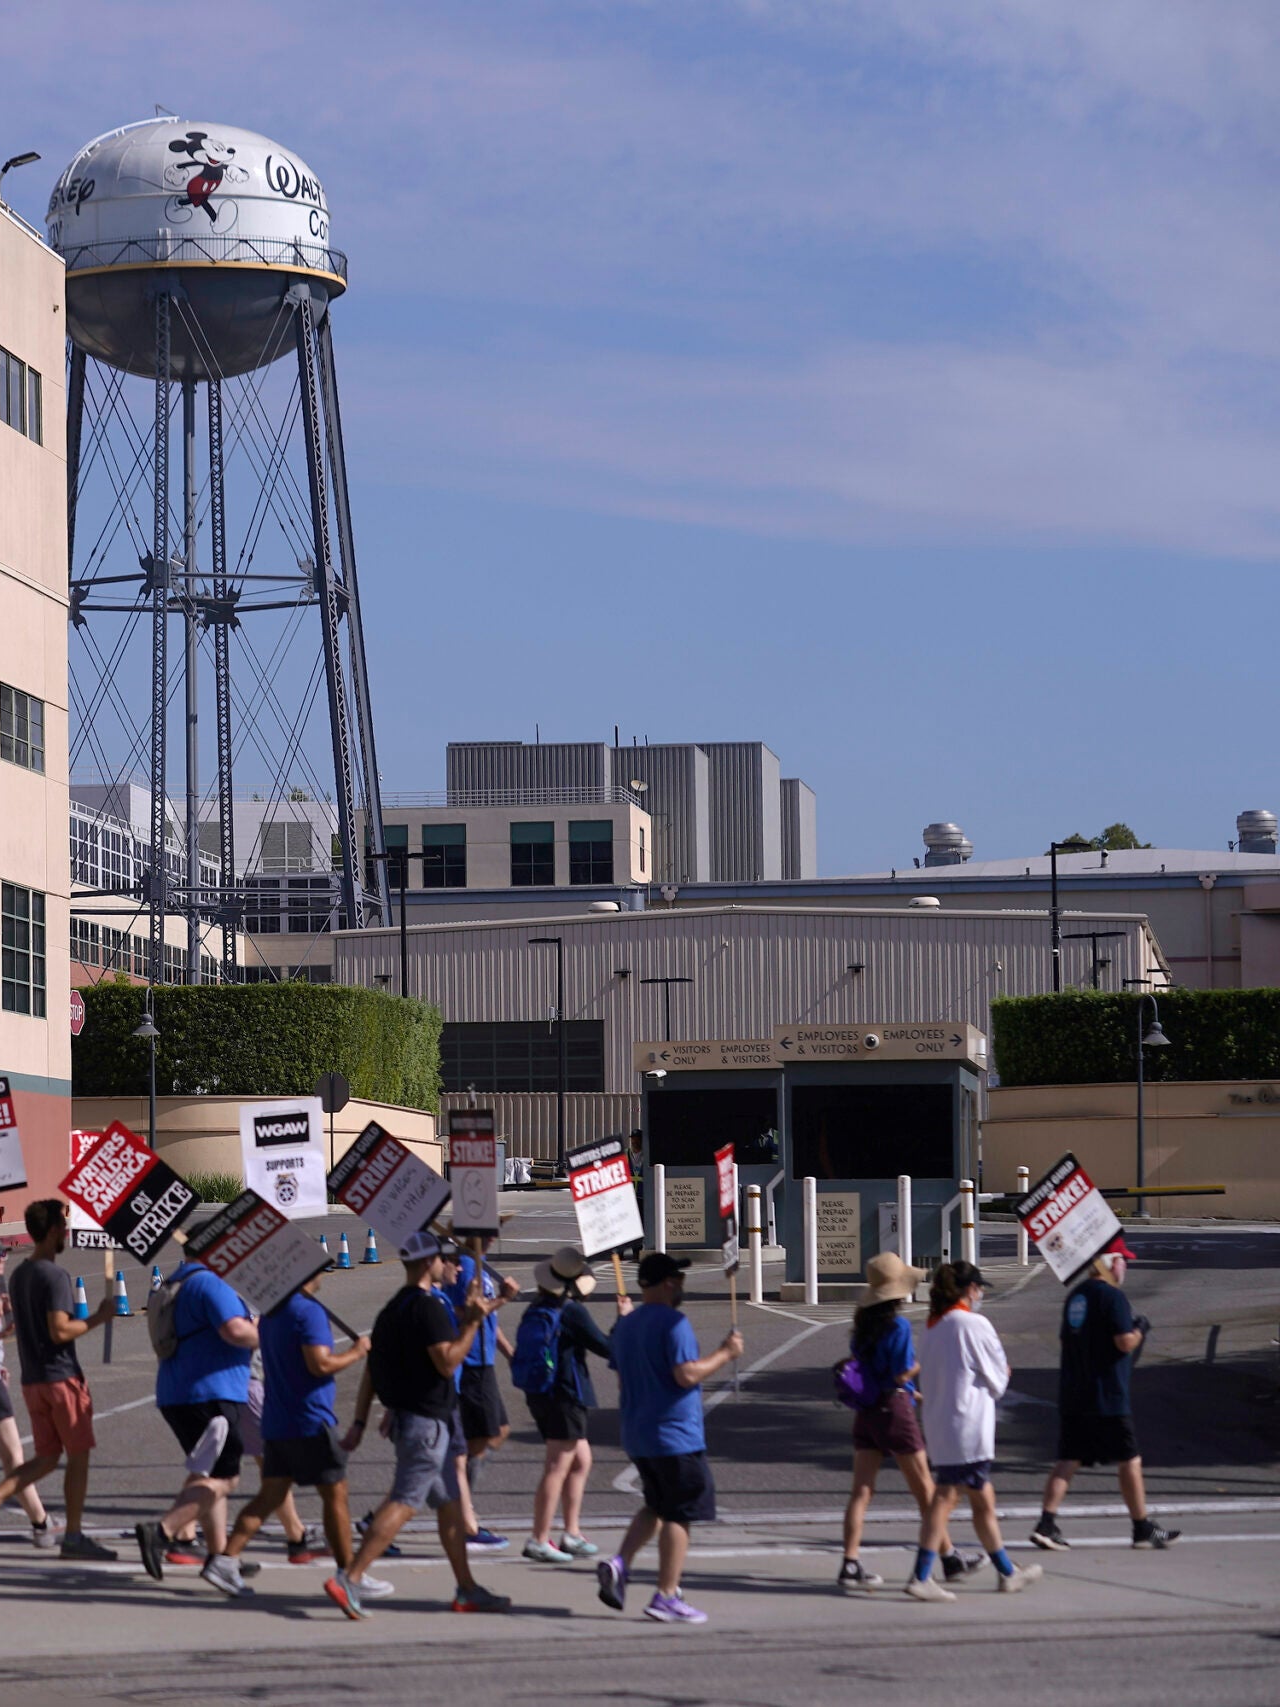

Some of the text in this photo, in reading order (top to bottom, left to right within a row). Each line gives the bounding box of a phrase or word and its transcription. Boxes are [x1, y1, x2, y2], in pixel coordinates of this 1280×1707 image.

[797, 1030, 859, 1041] EMPLOYEES
[883, 1029, 945, 1040] EMPLOYEES
[673, 1045, 711, 1054] VISITORS
[720, 1044, 771, 1053] EMPLOYEES
[798, 1044, 859, 1055] & VISITORS
[915, 1043, 945, 1053] ONLY
[673, 1057, 697, 1065] ONLY
[722, 1055, 771, 1064] & VISITORS
[256, 1121, 307, 1138] WGAW
[67, 1131, 126, 1195] WRITERS
[266, 1157, 304, 1171] SUPPORTS
[83, 1157, 124, 1203] GUILD
[120, 1144, 136, 1161] OF
[345, 1139, 405, 1210] STRIKE!
[573, 1160, 628, 1198] STRIKE!
[92, 1151, 152, 1219] AMERICA
[130, 1190, 153, 1216] ON
[1029, 1174, 1090, 1238] STRIKE!
[126, 1180, 193, 1256] STRIKE
[207, 1208, 281, 1273] STRIKE!
